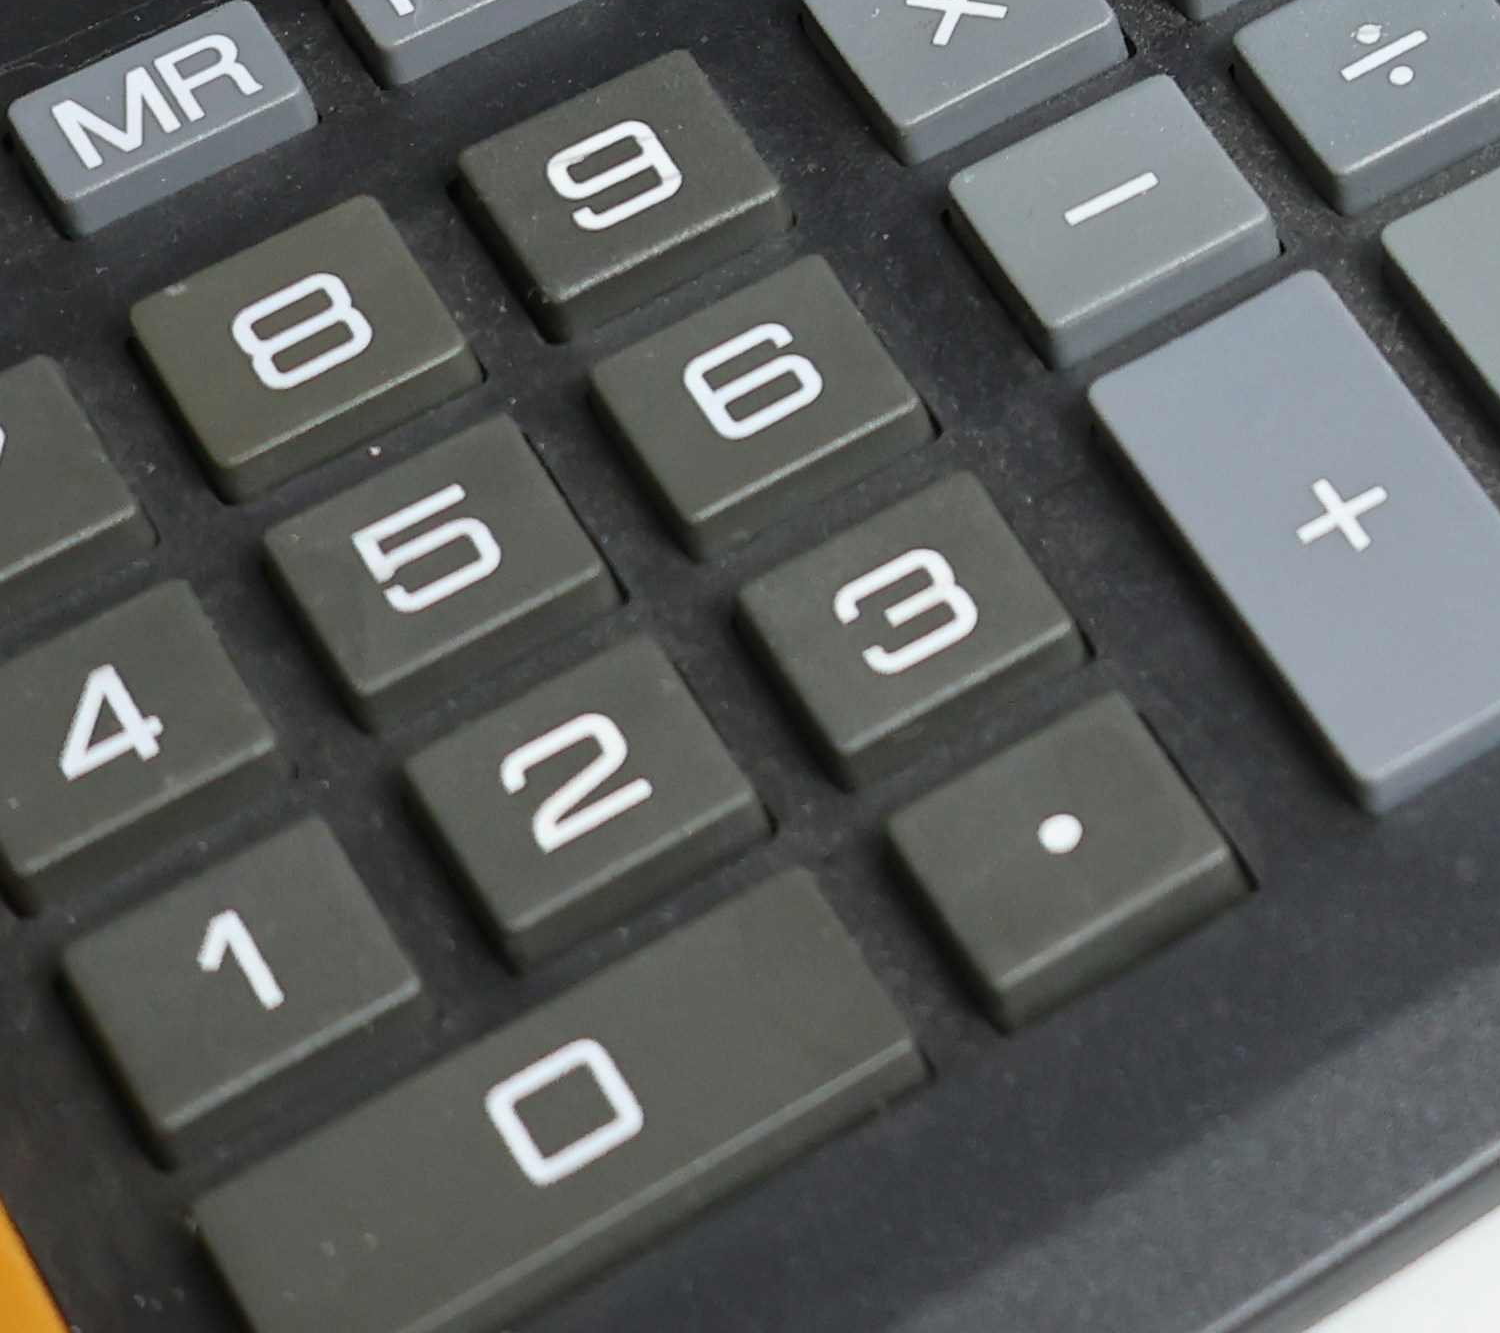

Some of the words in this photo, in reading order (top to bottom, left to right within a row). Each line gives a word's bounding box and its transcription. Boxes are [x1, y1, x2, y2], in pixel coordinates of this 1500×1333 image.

[52, 34, 263, 169] MR
[547, 121, 682, 233] 9
[232, 273, 373, 390] 8
[684, 323, 823, 441] 6
[353, 484, 501, 612] 5
[1297, 479, 1387, 551] +
[834, 548, 978, 675] 3
[60, 665, 163, 780] 4
[501, 713, 652, 852] 2
[197, 909, 283, 1009] 1
[486, 1037, 643, 1187] 0
